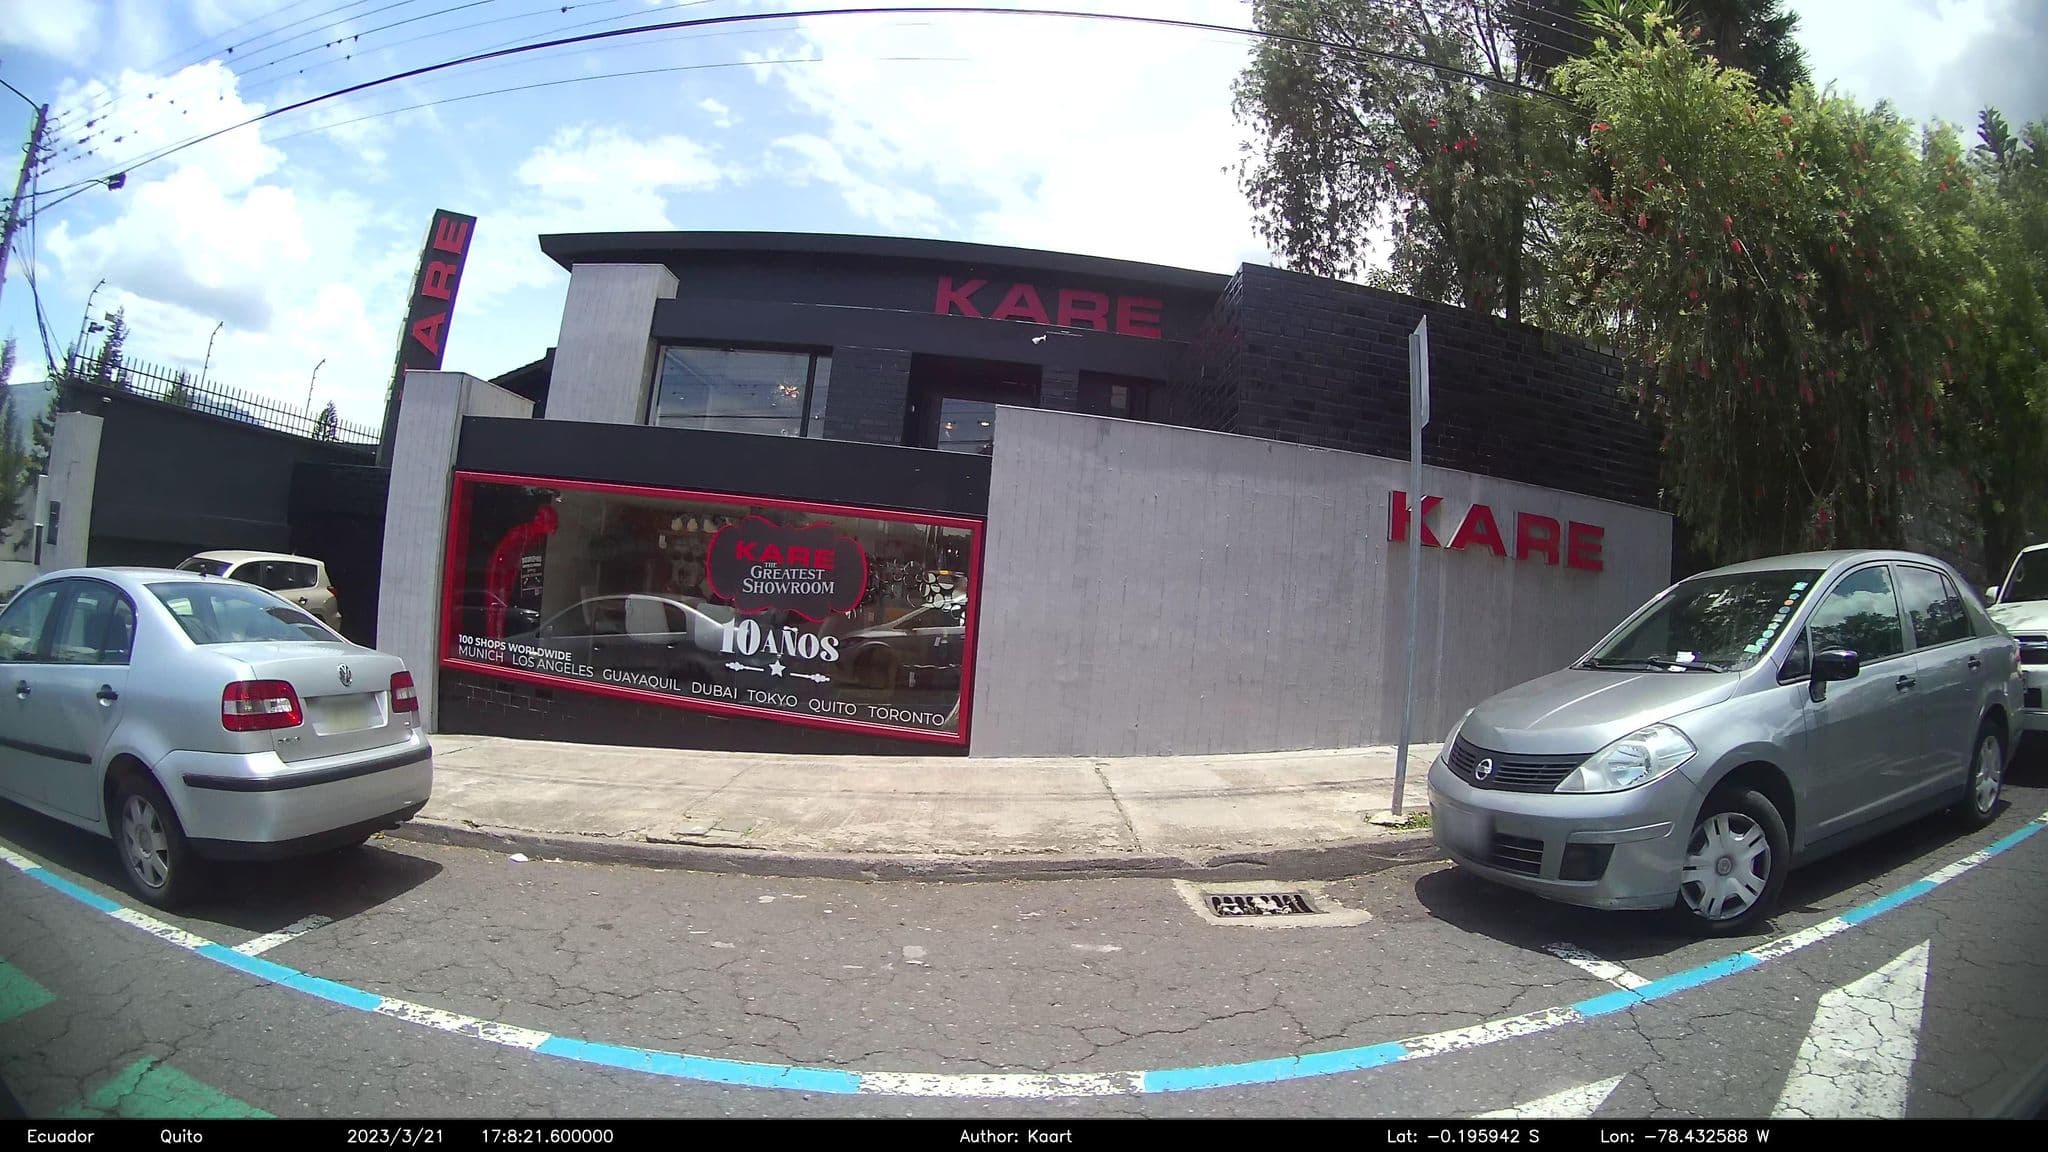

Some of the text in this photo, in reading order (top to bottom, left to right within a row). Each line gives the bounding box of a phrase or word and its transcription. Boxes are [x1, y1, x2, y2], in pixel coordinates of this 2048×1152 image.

[405, 216, 469, 368] ARE
[934, 275, 1164, 340] KARE
[1387, 490, 1605, 573] KARE
[735, 540, 836, 570] KARE
[764, 561, 778, 569] THE
[742, 578, 835, 595] SHOWROOM
[750, 565, 825, 581] GREATEST
[458, 634, 572, 662] 100 SHOPS WORLDWIDE
[458, 645, 945, 727] MUNICH LOS ANGELES GUAYAQUIL DUBAI TOKYO QUITO TORONTO
